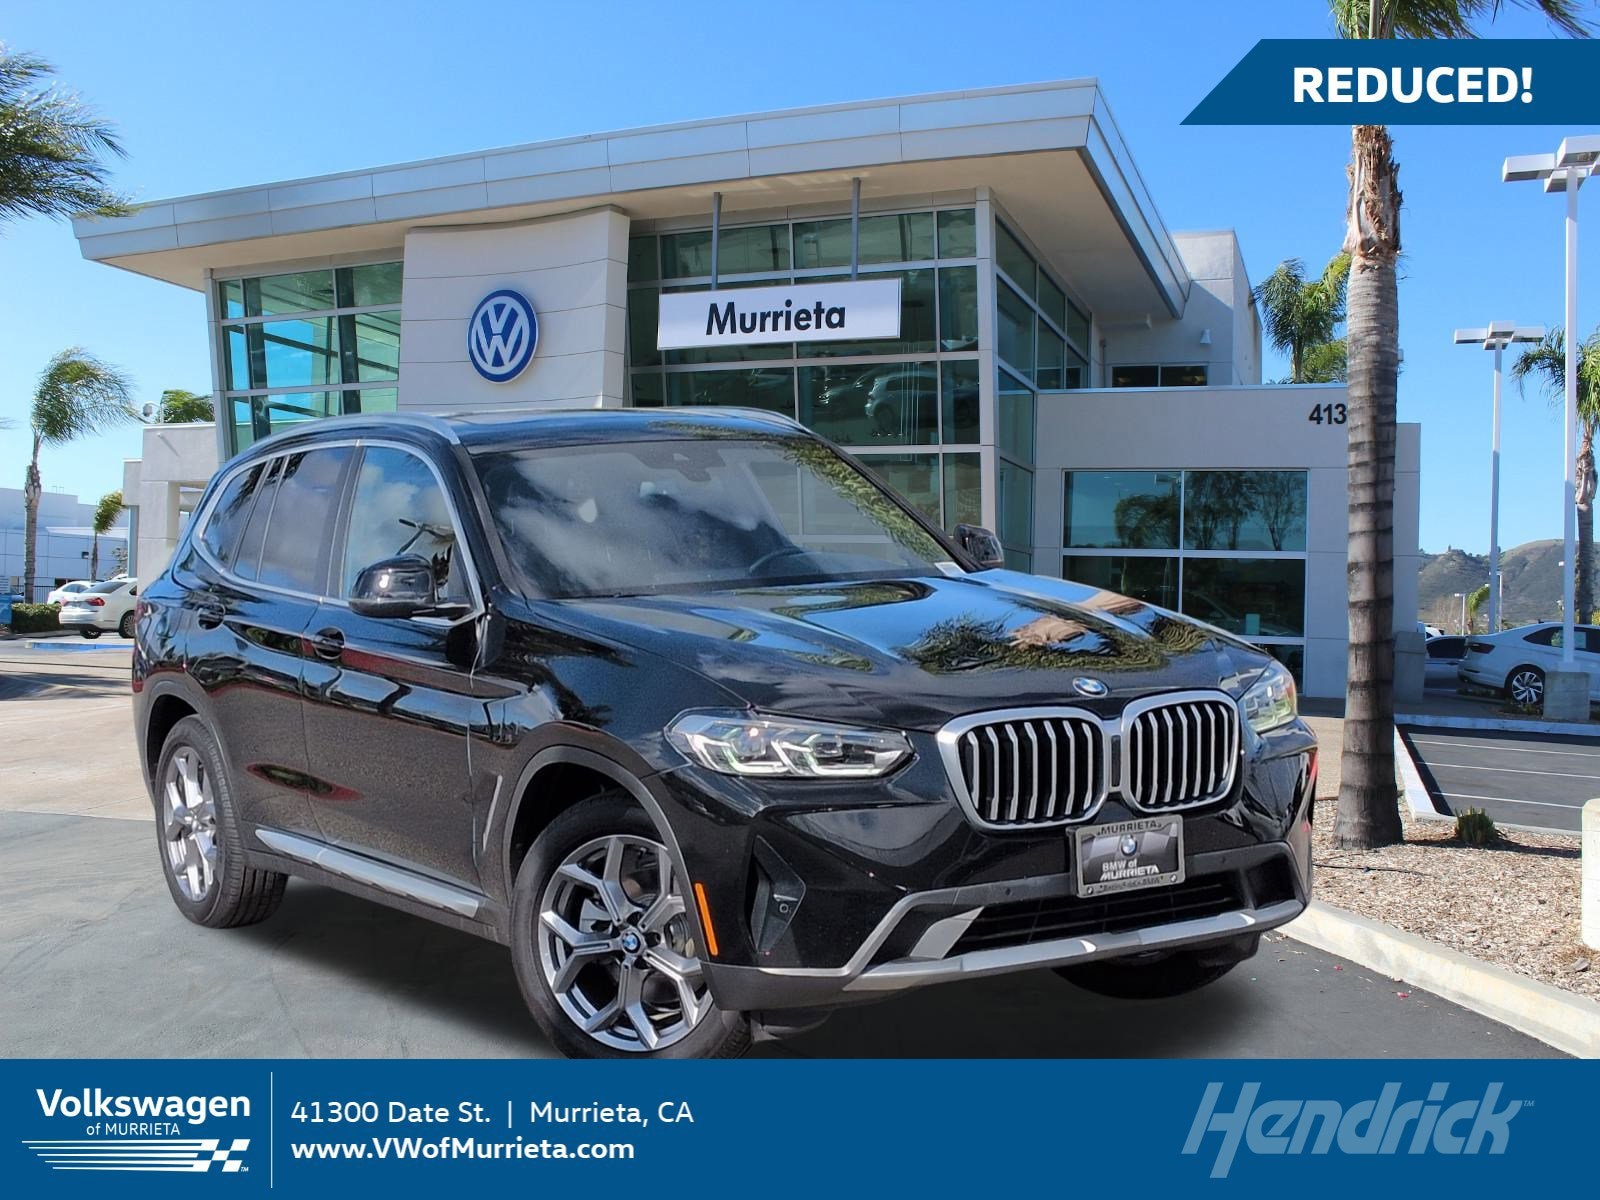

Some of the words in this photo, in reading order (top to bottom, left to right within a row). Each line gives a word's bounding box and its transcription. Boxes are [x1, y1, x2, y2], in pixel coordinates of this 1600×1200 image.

[705, 299, 847, 336] Murrieta
[1102, 821, 1157, 835] MURRIETA
[1100, 865, 1160, 881] MURRIETA
[1102, 860, 1127, 872] BMW
[1128, 859, 1138, 868] of
